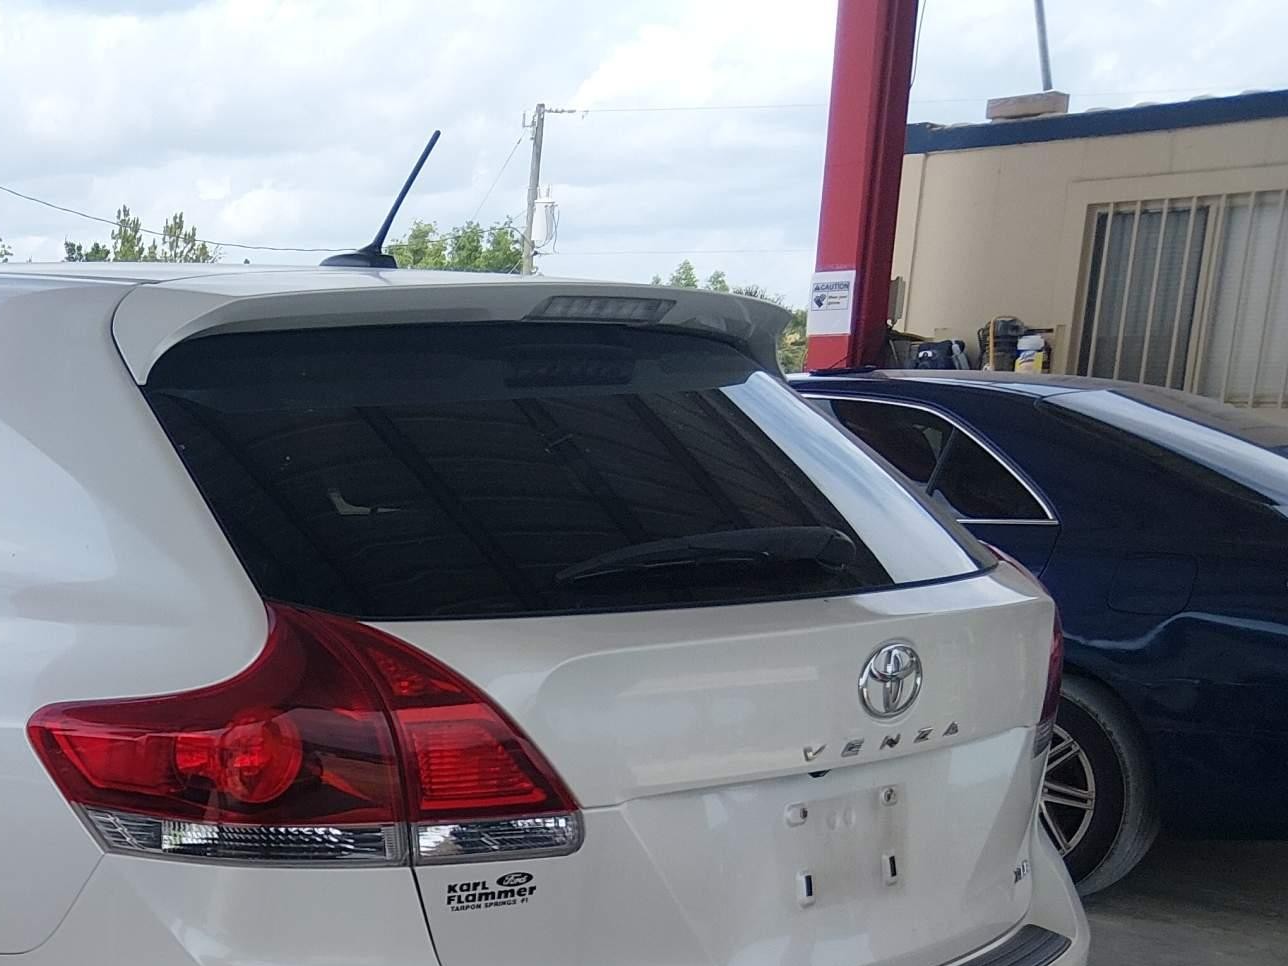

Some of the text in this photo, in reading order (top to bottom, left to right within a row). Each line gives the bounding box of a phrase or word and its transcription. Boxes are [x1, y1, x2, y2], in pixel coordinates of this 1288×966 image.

[820, 282, 850, 291] CAUTION
[802, 720, 959, 763] VENZA
[450, 903, 482, 912] TARPON
[484, 898, 517, 909] SPRINGS
